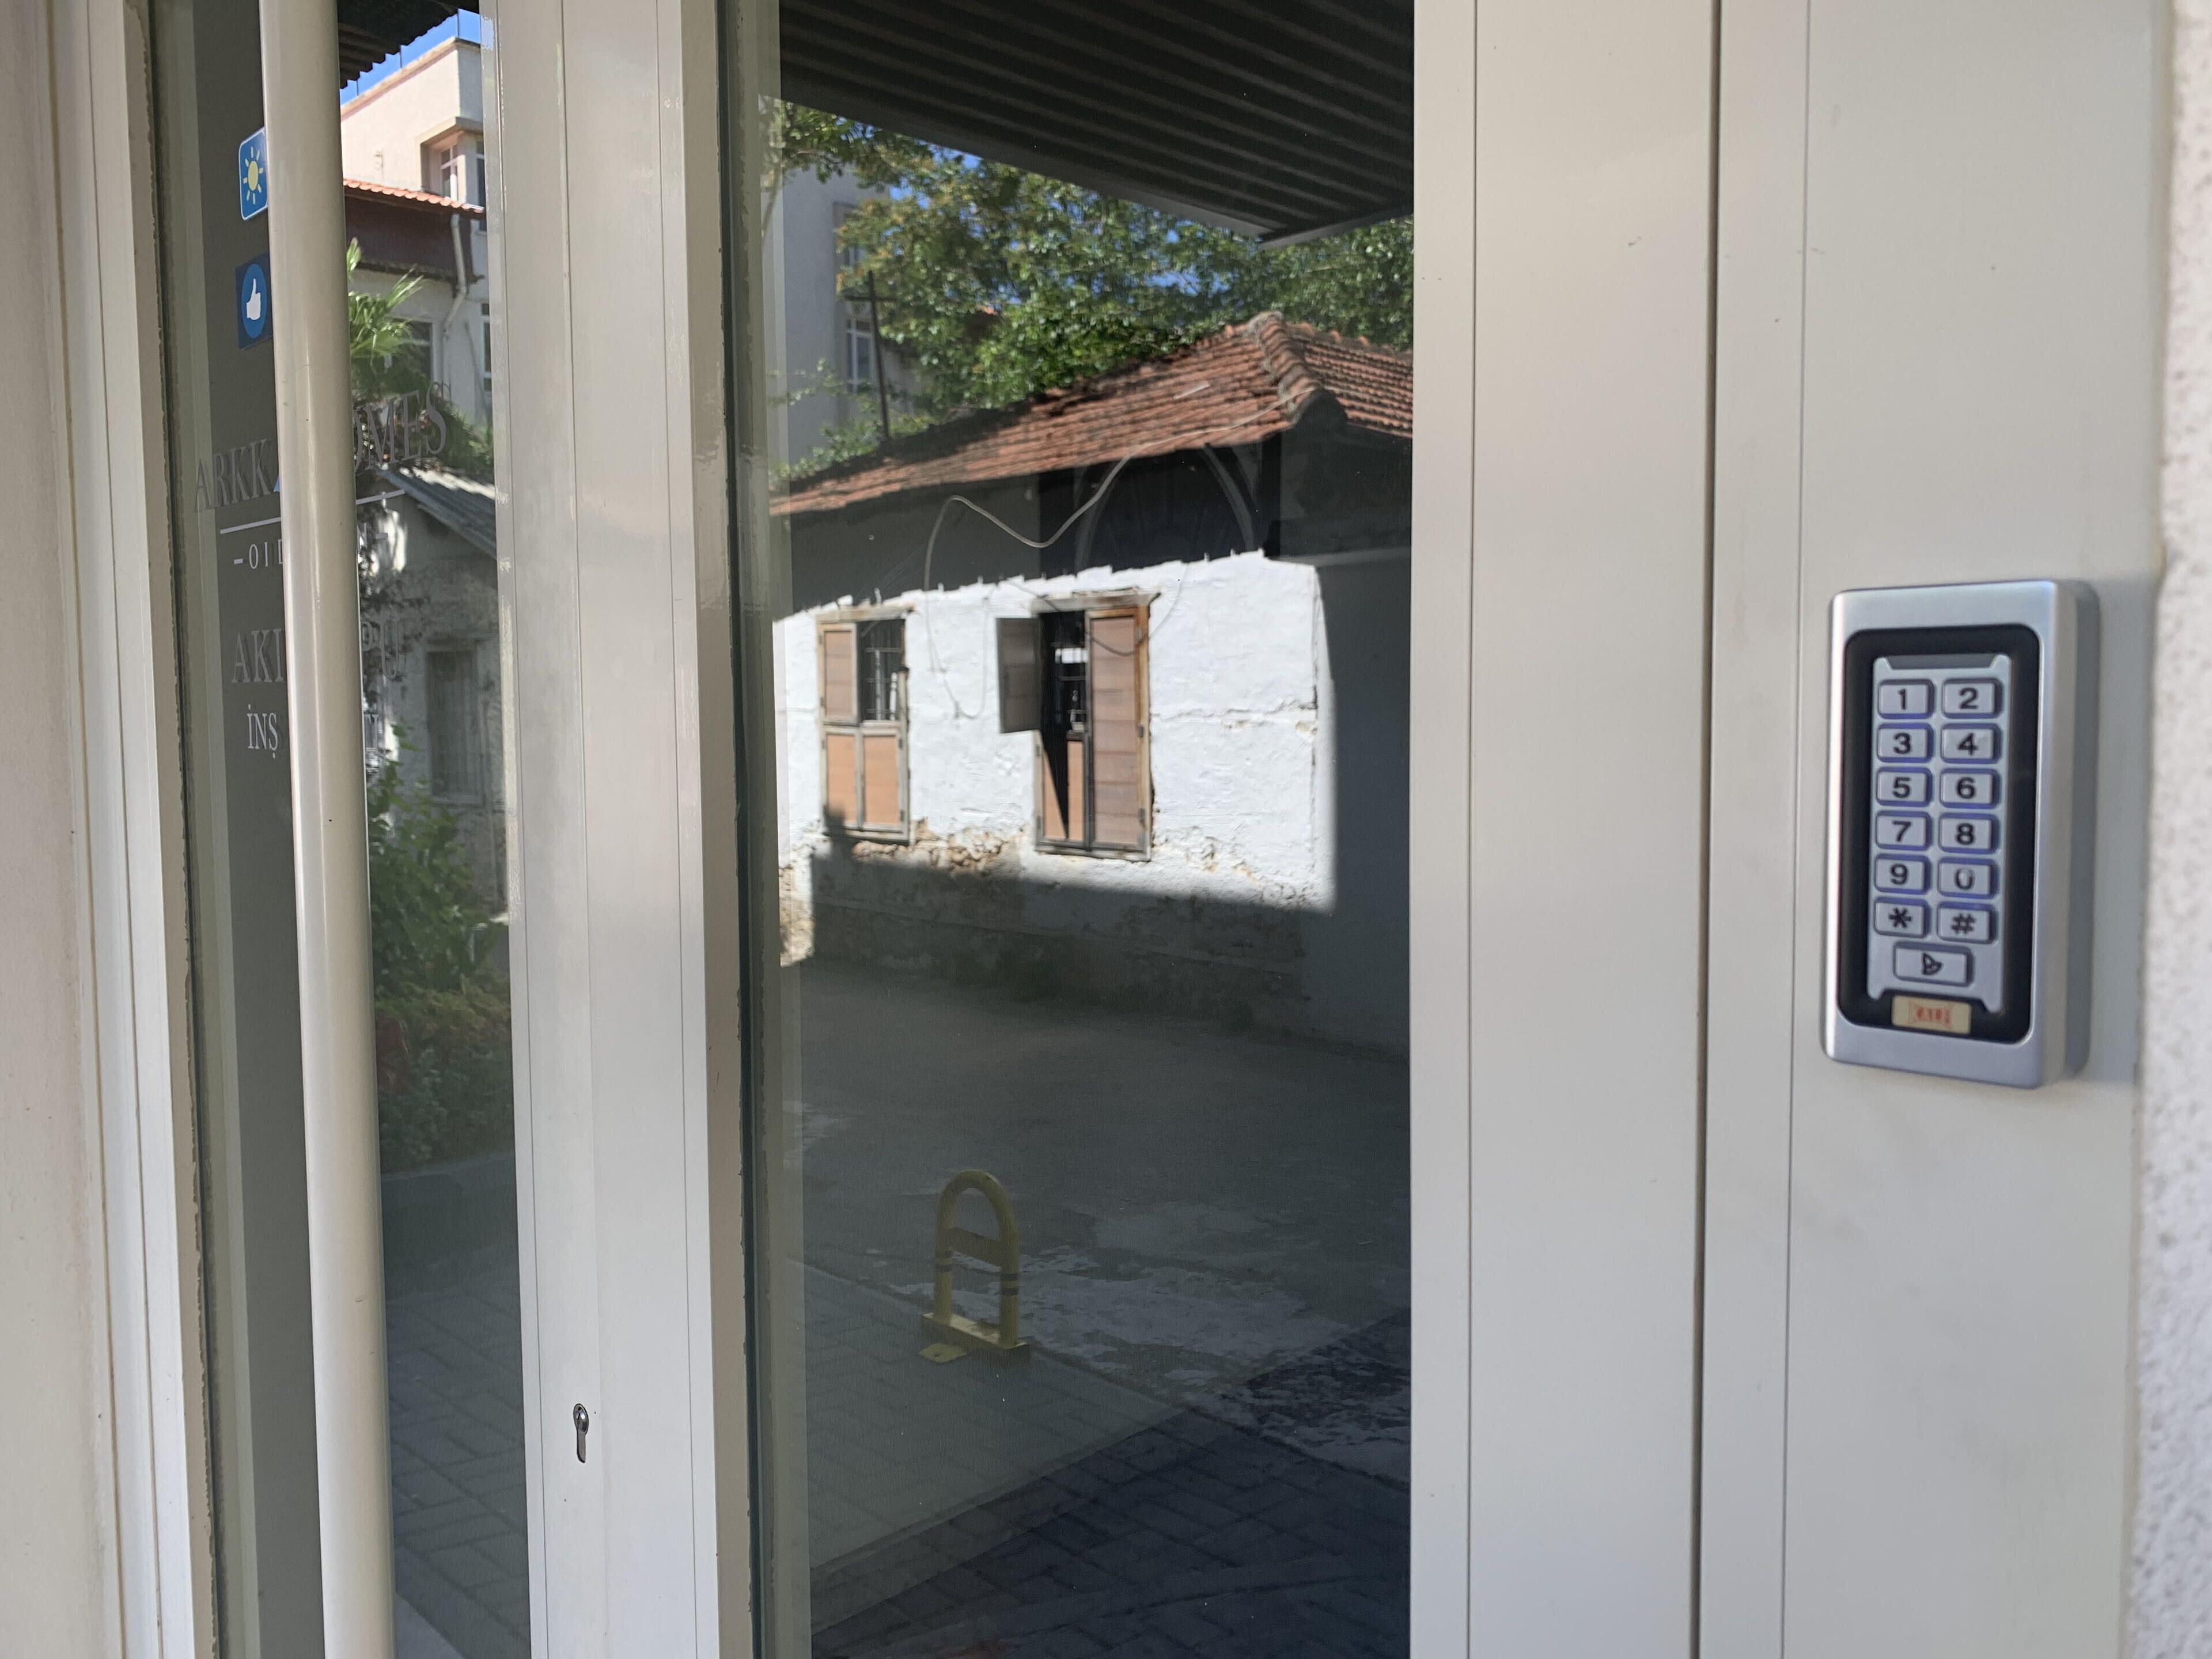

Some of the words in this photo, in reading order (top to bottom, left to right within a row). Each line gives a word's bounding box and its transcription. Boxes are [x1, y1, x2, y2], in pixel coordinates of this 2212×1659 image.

[1897, 688, 1907, 710] 1
[1959, 687, 1979, 710] 2
[1893, 732, 1911, 755] 3
[1957, 732, 1978, 756] 4
[1893, 777, 1911, 798] 5
[1956, 777, 1976, 800] 6
[1892, 820, 1912, 842] 7
[1956, 823, 1975, 845] 8
[1890, 863, 1908, 885] 9
